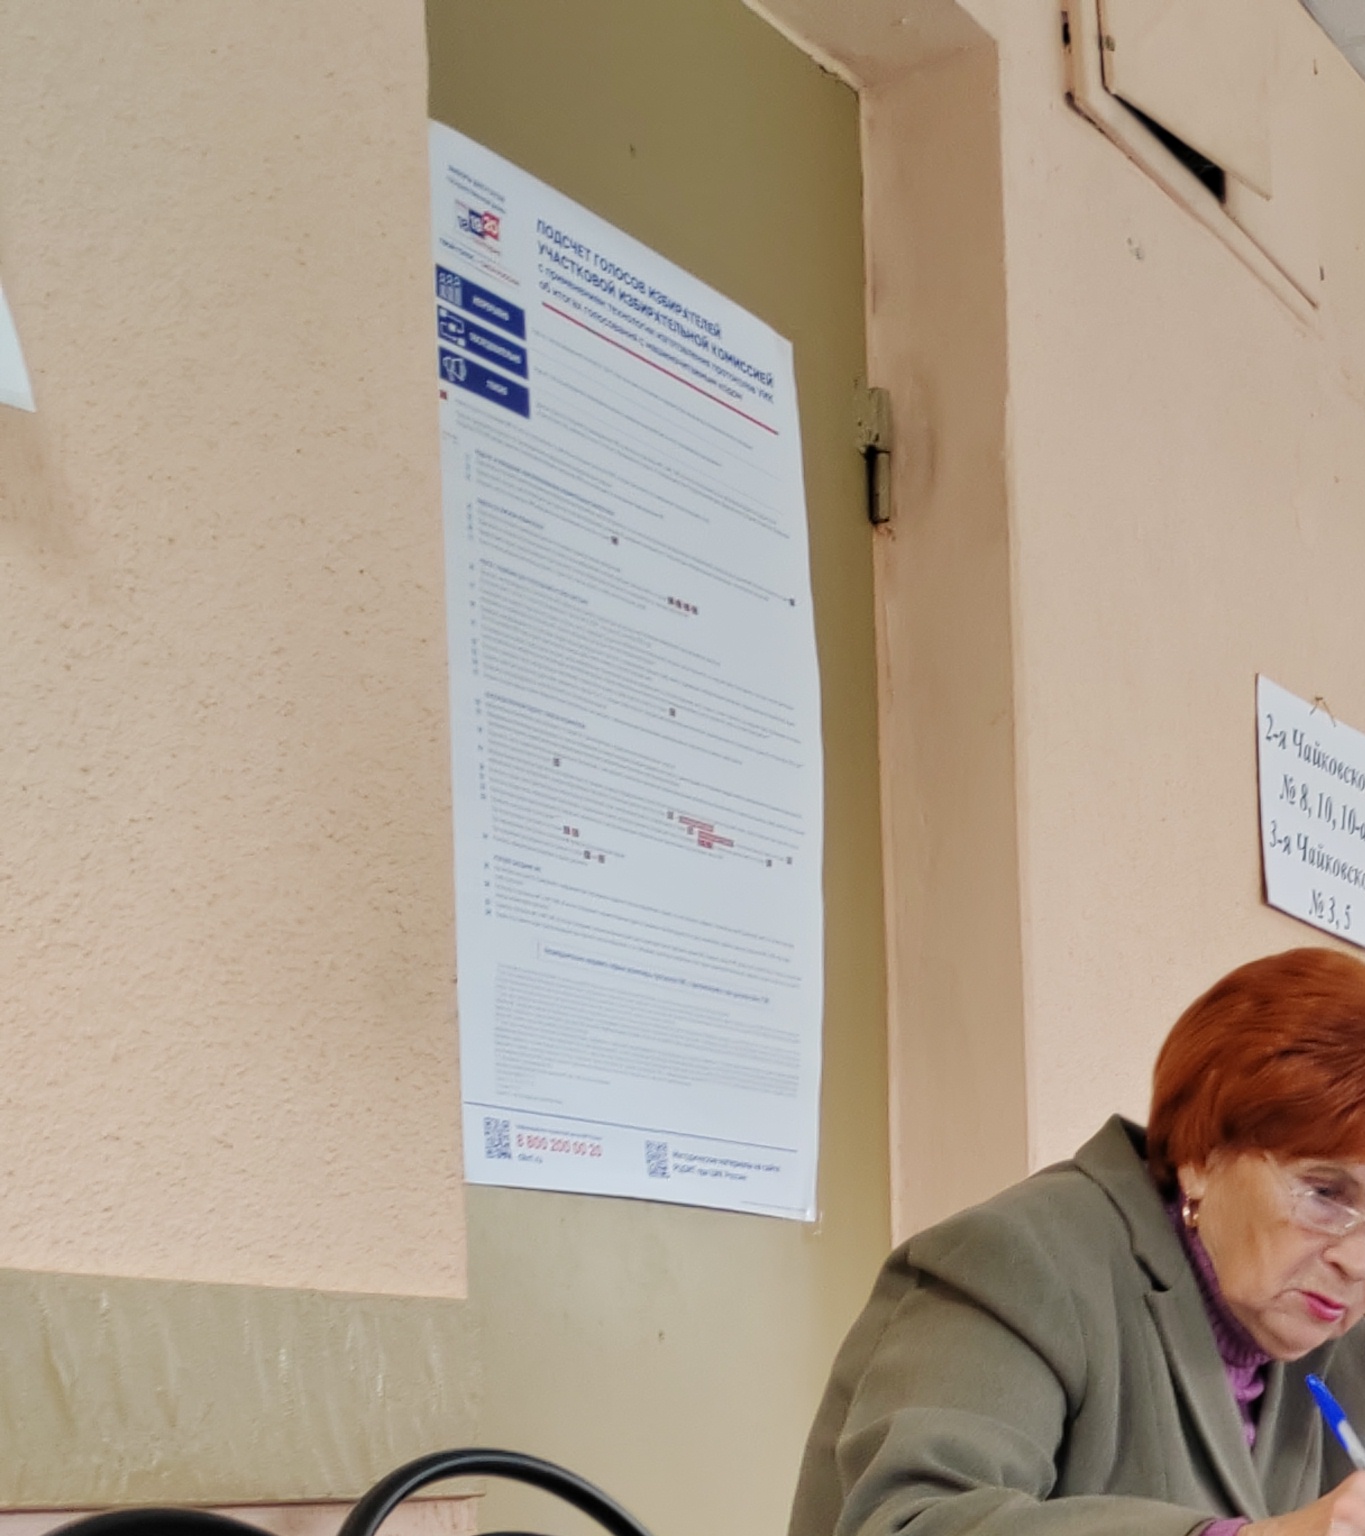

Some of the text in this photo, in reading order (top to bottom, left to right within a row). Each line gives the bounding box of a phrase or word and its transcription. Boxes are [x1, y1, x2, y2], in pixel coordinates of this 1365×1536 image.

[536, 218, 722, 339] ПОДСЧЕТ ГОЛОСОВ ИЗБИРАТЕЛЕЙ
[538, 240, 616, 298] УЧАСТКОВОЙ
[618, 287, 710, 352] ИЗБИРАТЕЛЬНОЙ
[710, 342, 774, 389] КОМИССИЕЙ
[1265, 713, 1288, 750] 2-я
[1279, 773, 1297, 805] №
[1300, 783, 1313, 819] 8,
[1317, 792, 1337, 831] 10,
[1269, 819, 1292, 856] 3-я
[1308, 888, 1325, 919] №
[1327, 896, 1341, 930] 3,
